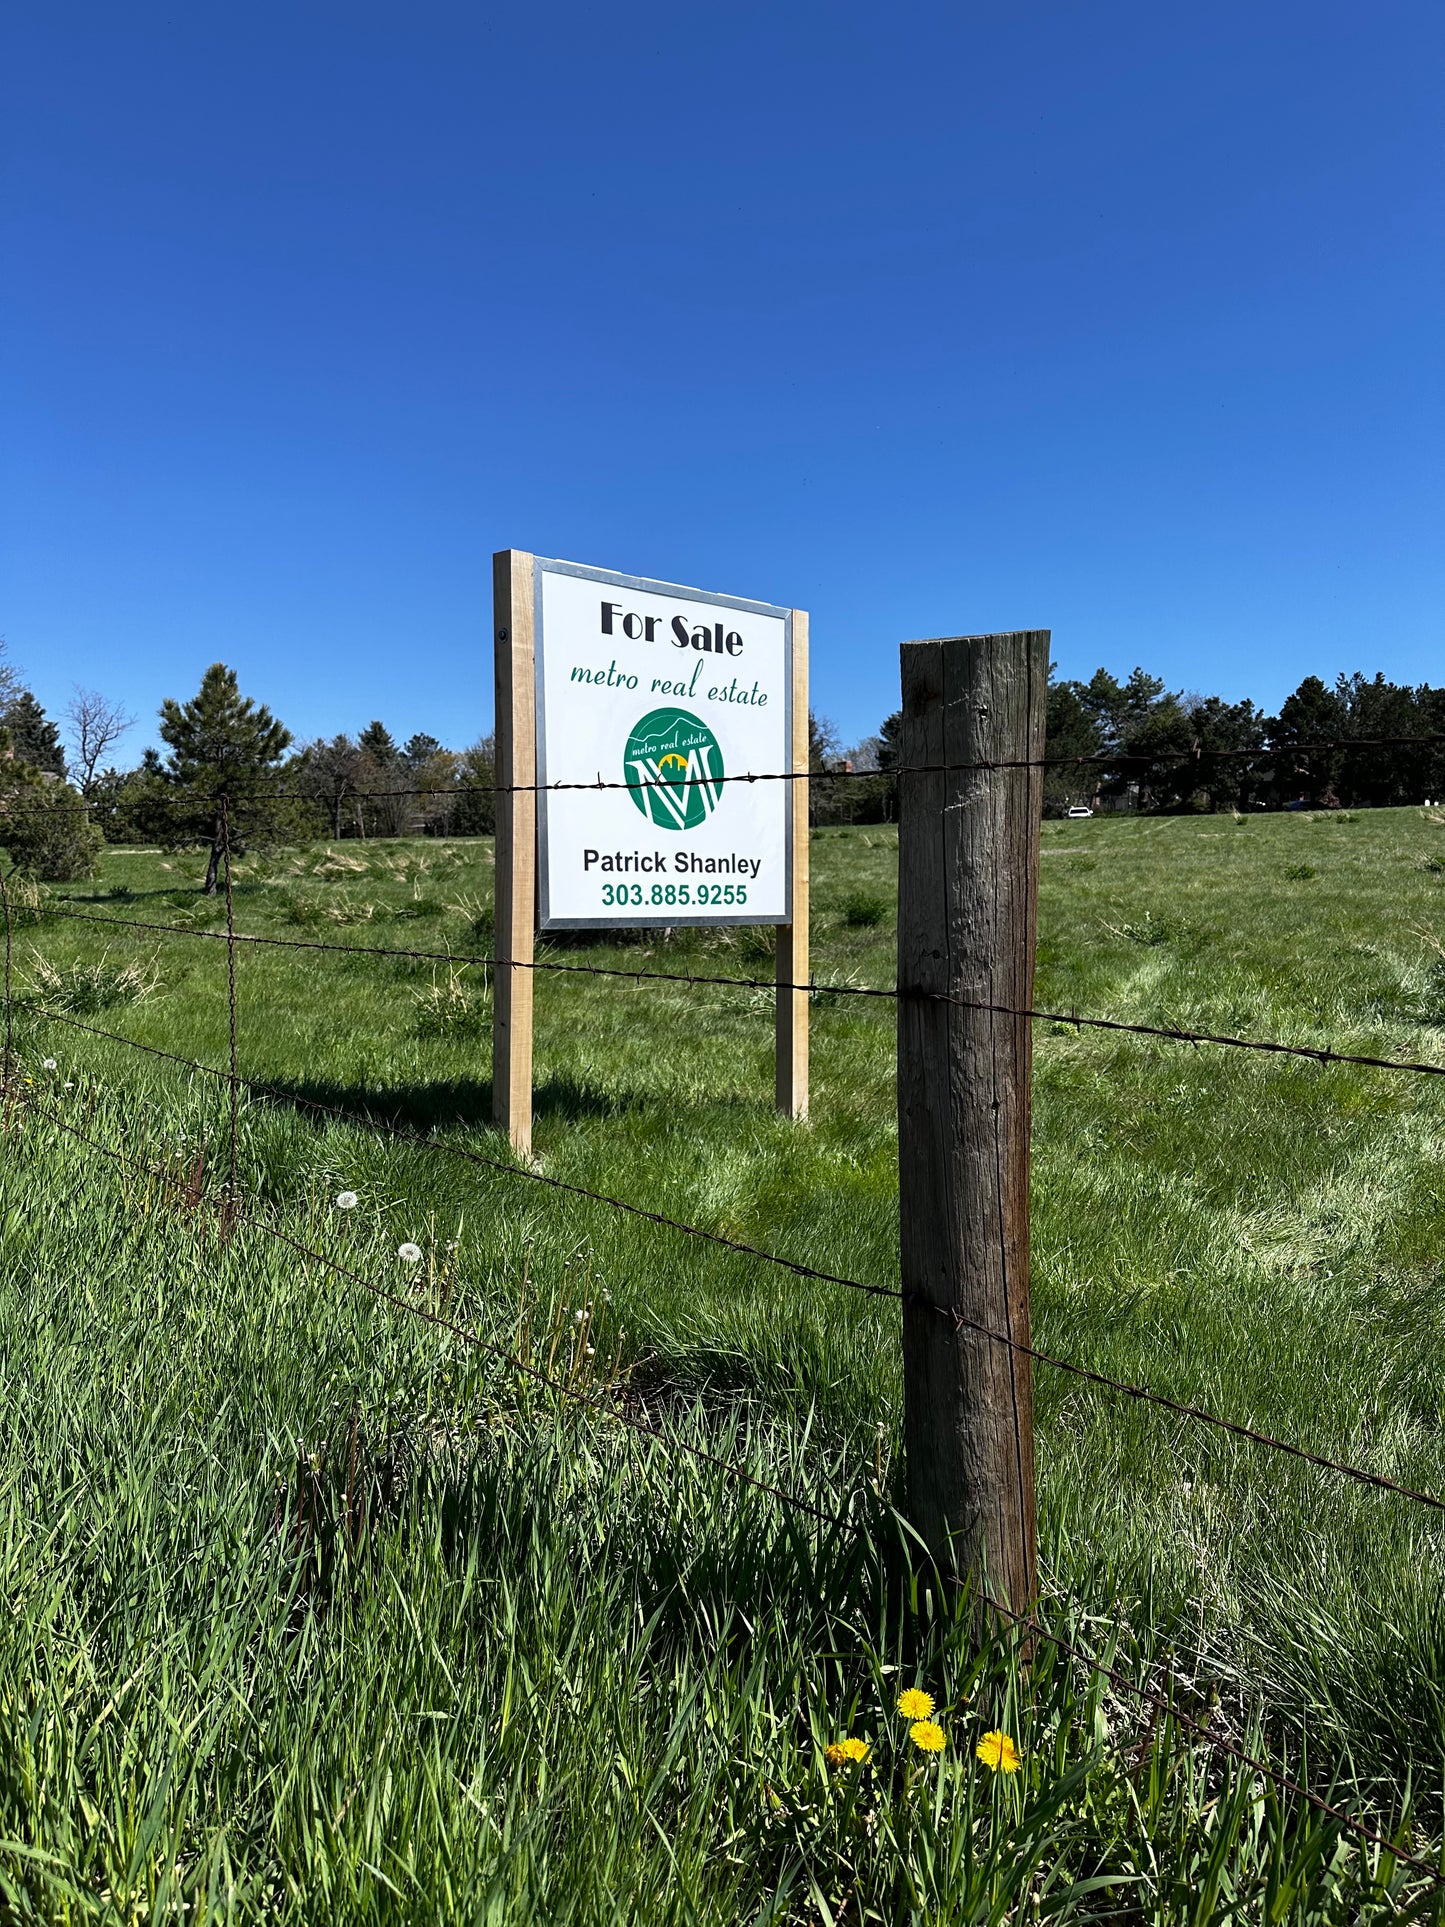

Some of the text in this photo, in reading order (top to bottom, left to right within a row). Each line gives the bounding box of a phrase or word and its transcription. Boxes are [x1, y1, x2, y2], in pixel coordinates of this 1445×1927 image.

[601, 601, 743, 657] For Sale
[570, 658, 768, 707] metro real estate
[632, 730, 707, 756] metro real estate
[583, 849, 761, 879] Patrick Shanley
[601, 883, 748, 906] 303.885.9255
